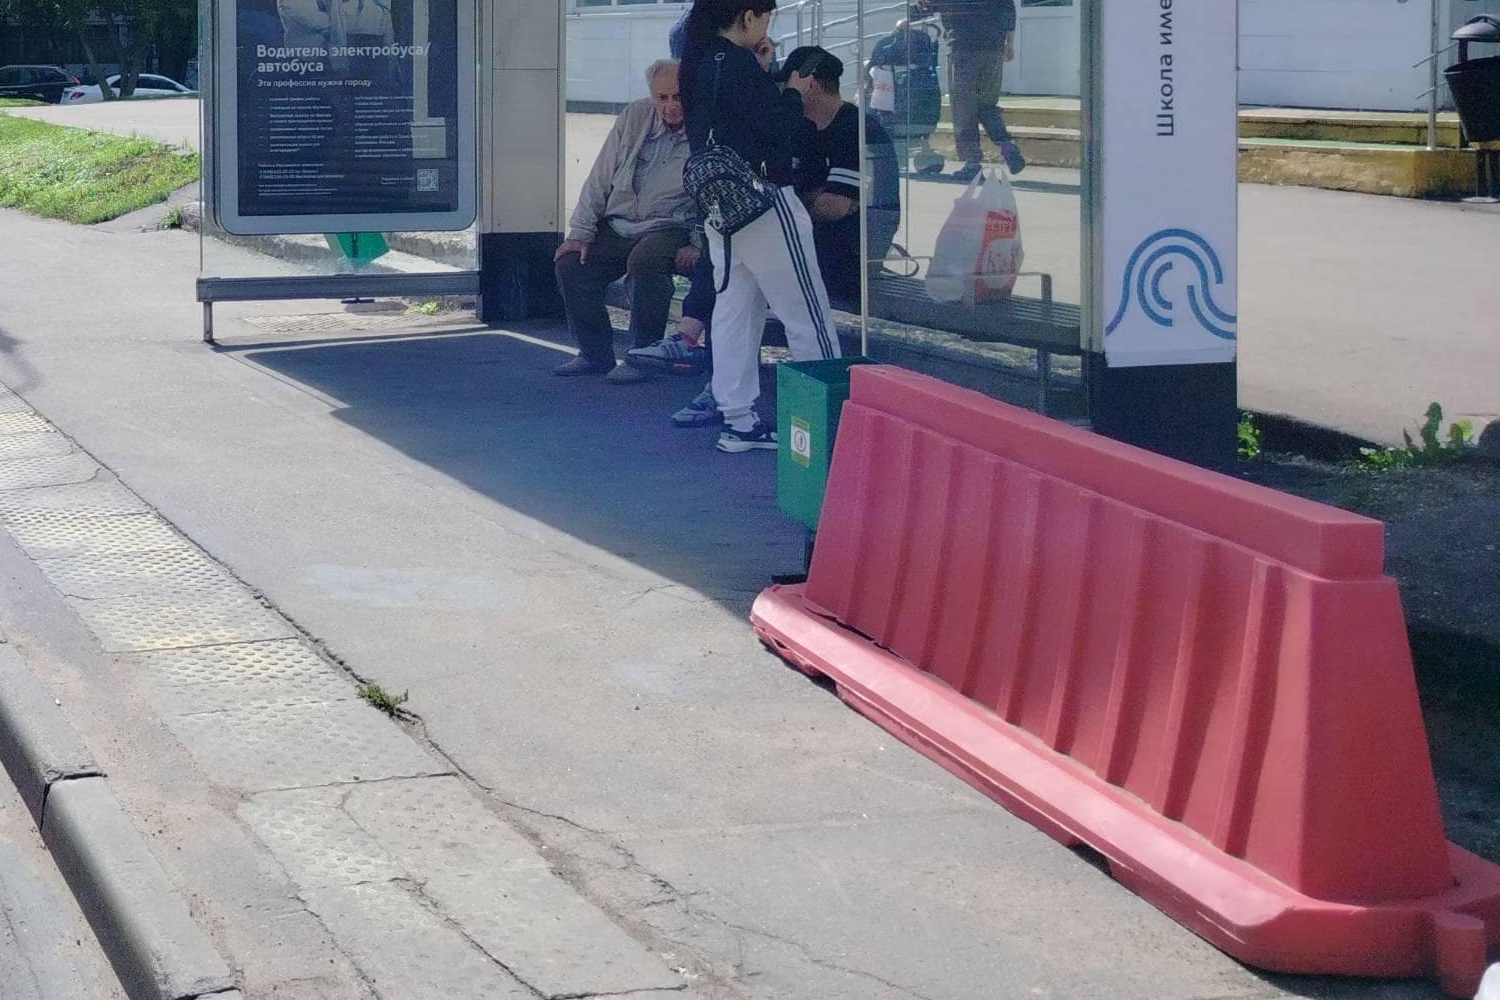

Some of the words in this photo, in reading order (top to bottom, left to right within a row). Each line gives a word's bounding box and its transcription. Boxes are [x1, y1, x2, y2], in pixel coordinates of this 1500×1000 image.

[256, 44, 328, 59] Водитель
[331, 42, 431, 59] электробуса/
[257, 59, 324, 74] автобуса
[257, 79, 272, 87] Эта
[273, 79, 317, 89] профессия
[318, 79, 343, 88] нужна
[344, 78, 372, 88] городу
[1156, 53, 1174, 137] Школа
